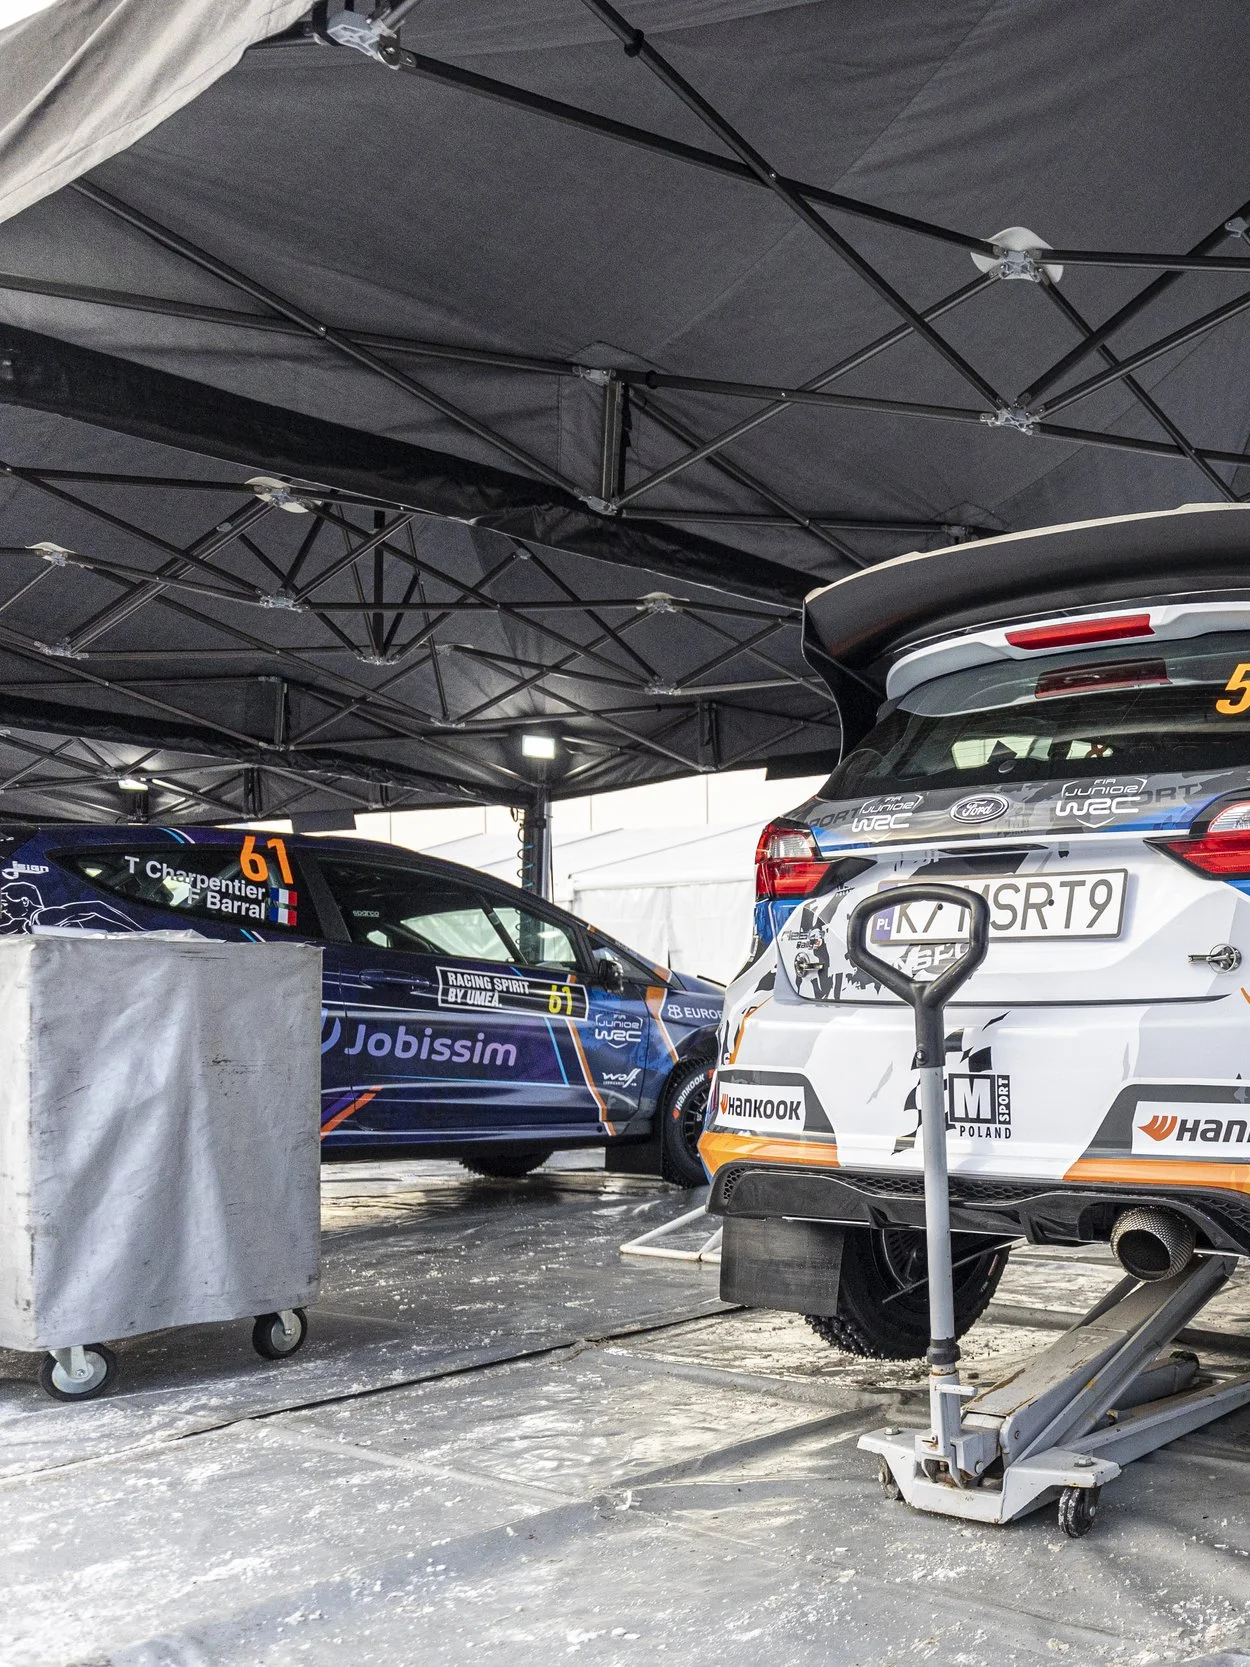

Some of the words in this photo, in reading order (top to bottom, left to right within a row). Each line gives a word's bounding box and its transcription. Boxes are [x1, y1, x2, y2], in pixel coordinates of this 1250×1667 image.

[1065, 785, 1139, 797] JUNIOR
[862, 802, 915, 814] JUNIOR
[962, 801, 994, 817] Ford
[1056, 796, 1141, 817] WRC
[851, 812, 914, 833] WRC
[240, 835, 294, 884] 61
[125, 856, 140, 873] T
[145, 860, 266, 900] Charpentier
[187, 887, 201, 904] F
[206, 892, 266, 920] Barral
[876, 917, 891, 931] PL
[447, 972, 493, 989] RACING
[494, 978, 530, 995] SPIRIT
[447, 988, 465, 1003] BY
[548, 984, 573, 1015] 61
[598, 1020, 641, 1029] JUNIOR
[344, 1024, 517, 1067] Jobissim
[594, 1029, 642, 1042] WRC
[953, 1078, 992, 1119] M
[998, 1077, 1010, 1122] SPORT
[960, 1125, 1012, 1139] POLAND
